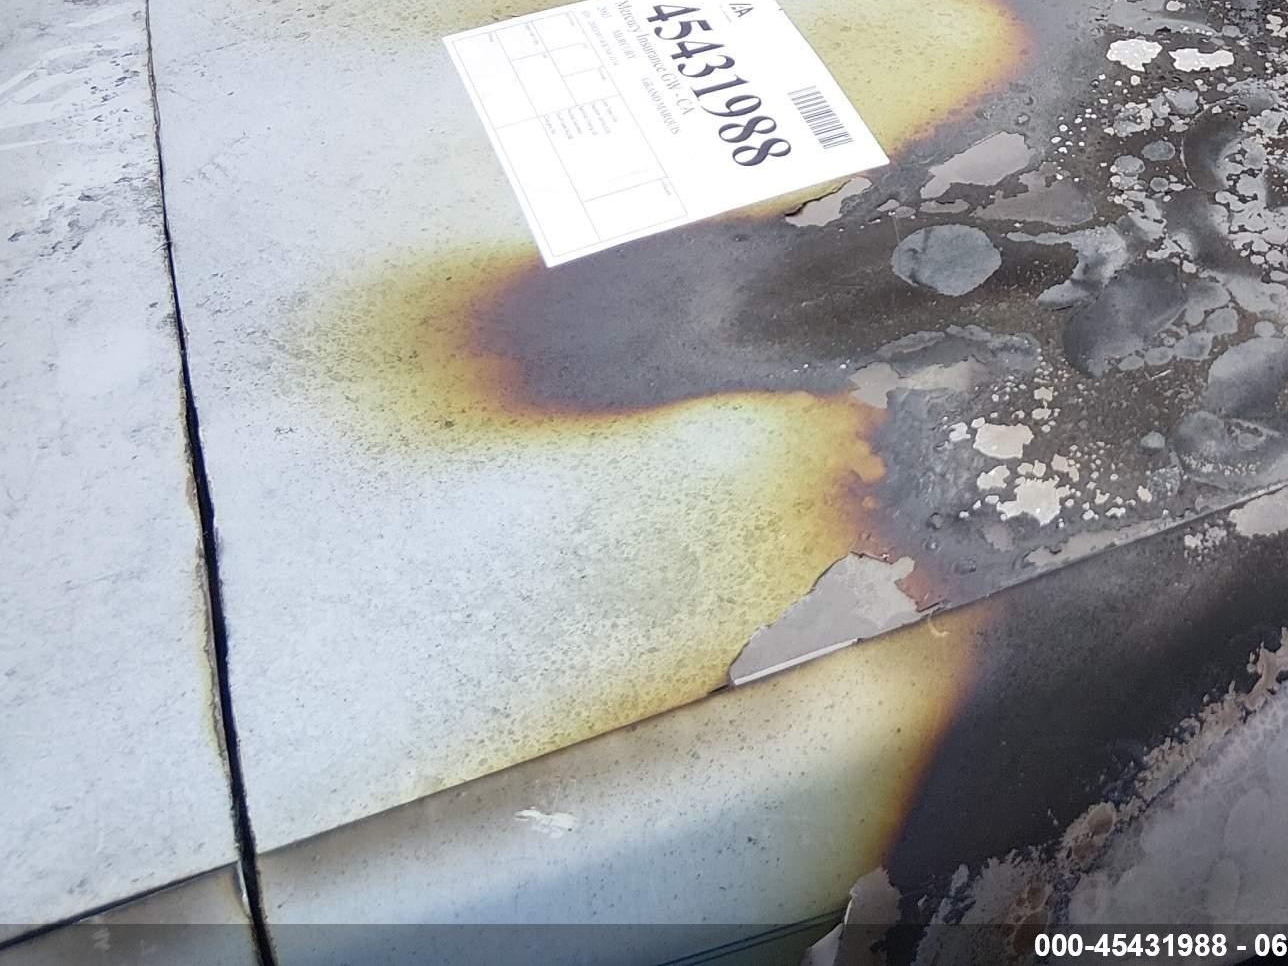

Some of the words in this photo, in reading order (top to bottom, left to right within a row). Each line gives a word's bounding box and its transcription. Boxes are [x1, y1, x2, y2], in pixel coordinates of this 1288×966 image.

[612, 29, 638, 59] MERCURY
[641, 76, 661, 103] GRAND
[656, 101, 681, 135] MARQUIS
[615, 0, 641, 33] Mercury
[636, 32, 666, 73] Insurance
[661, 72, 682, 90] GW
[676, 98, 695, 115] CA
[647, 4, 792, 167] 45431988
